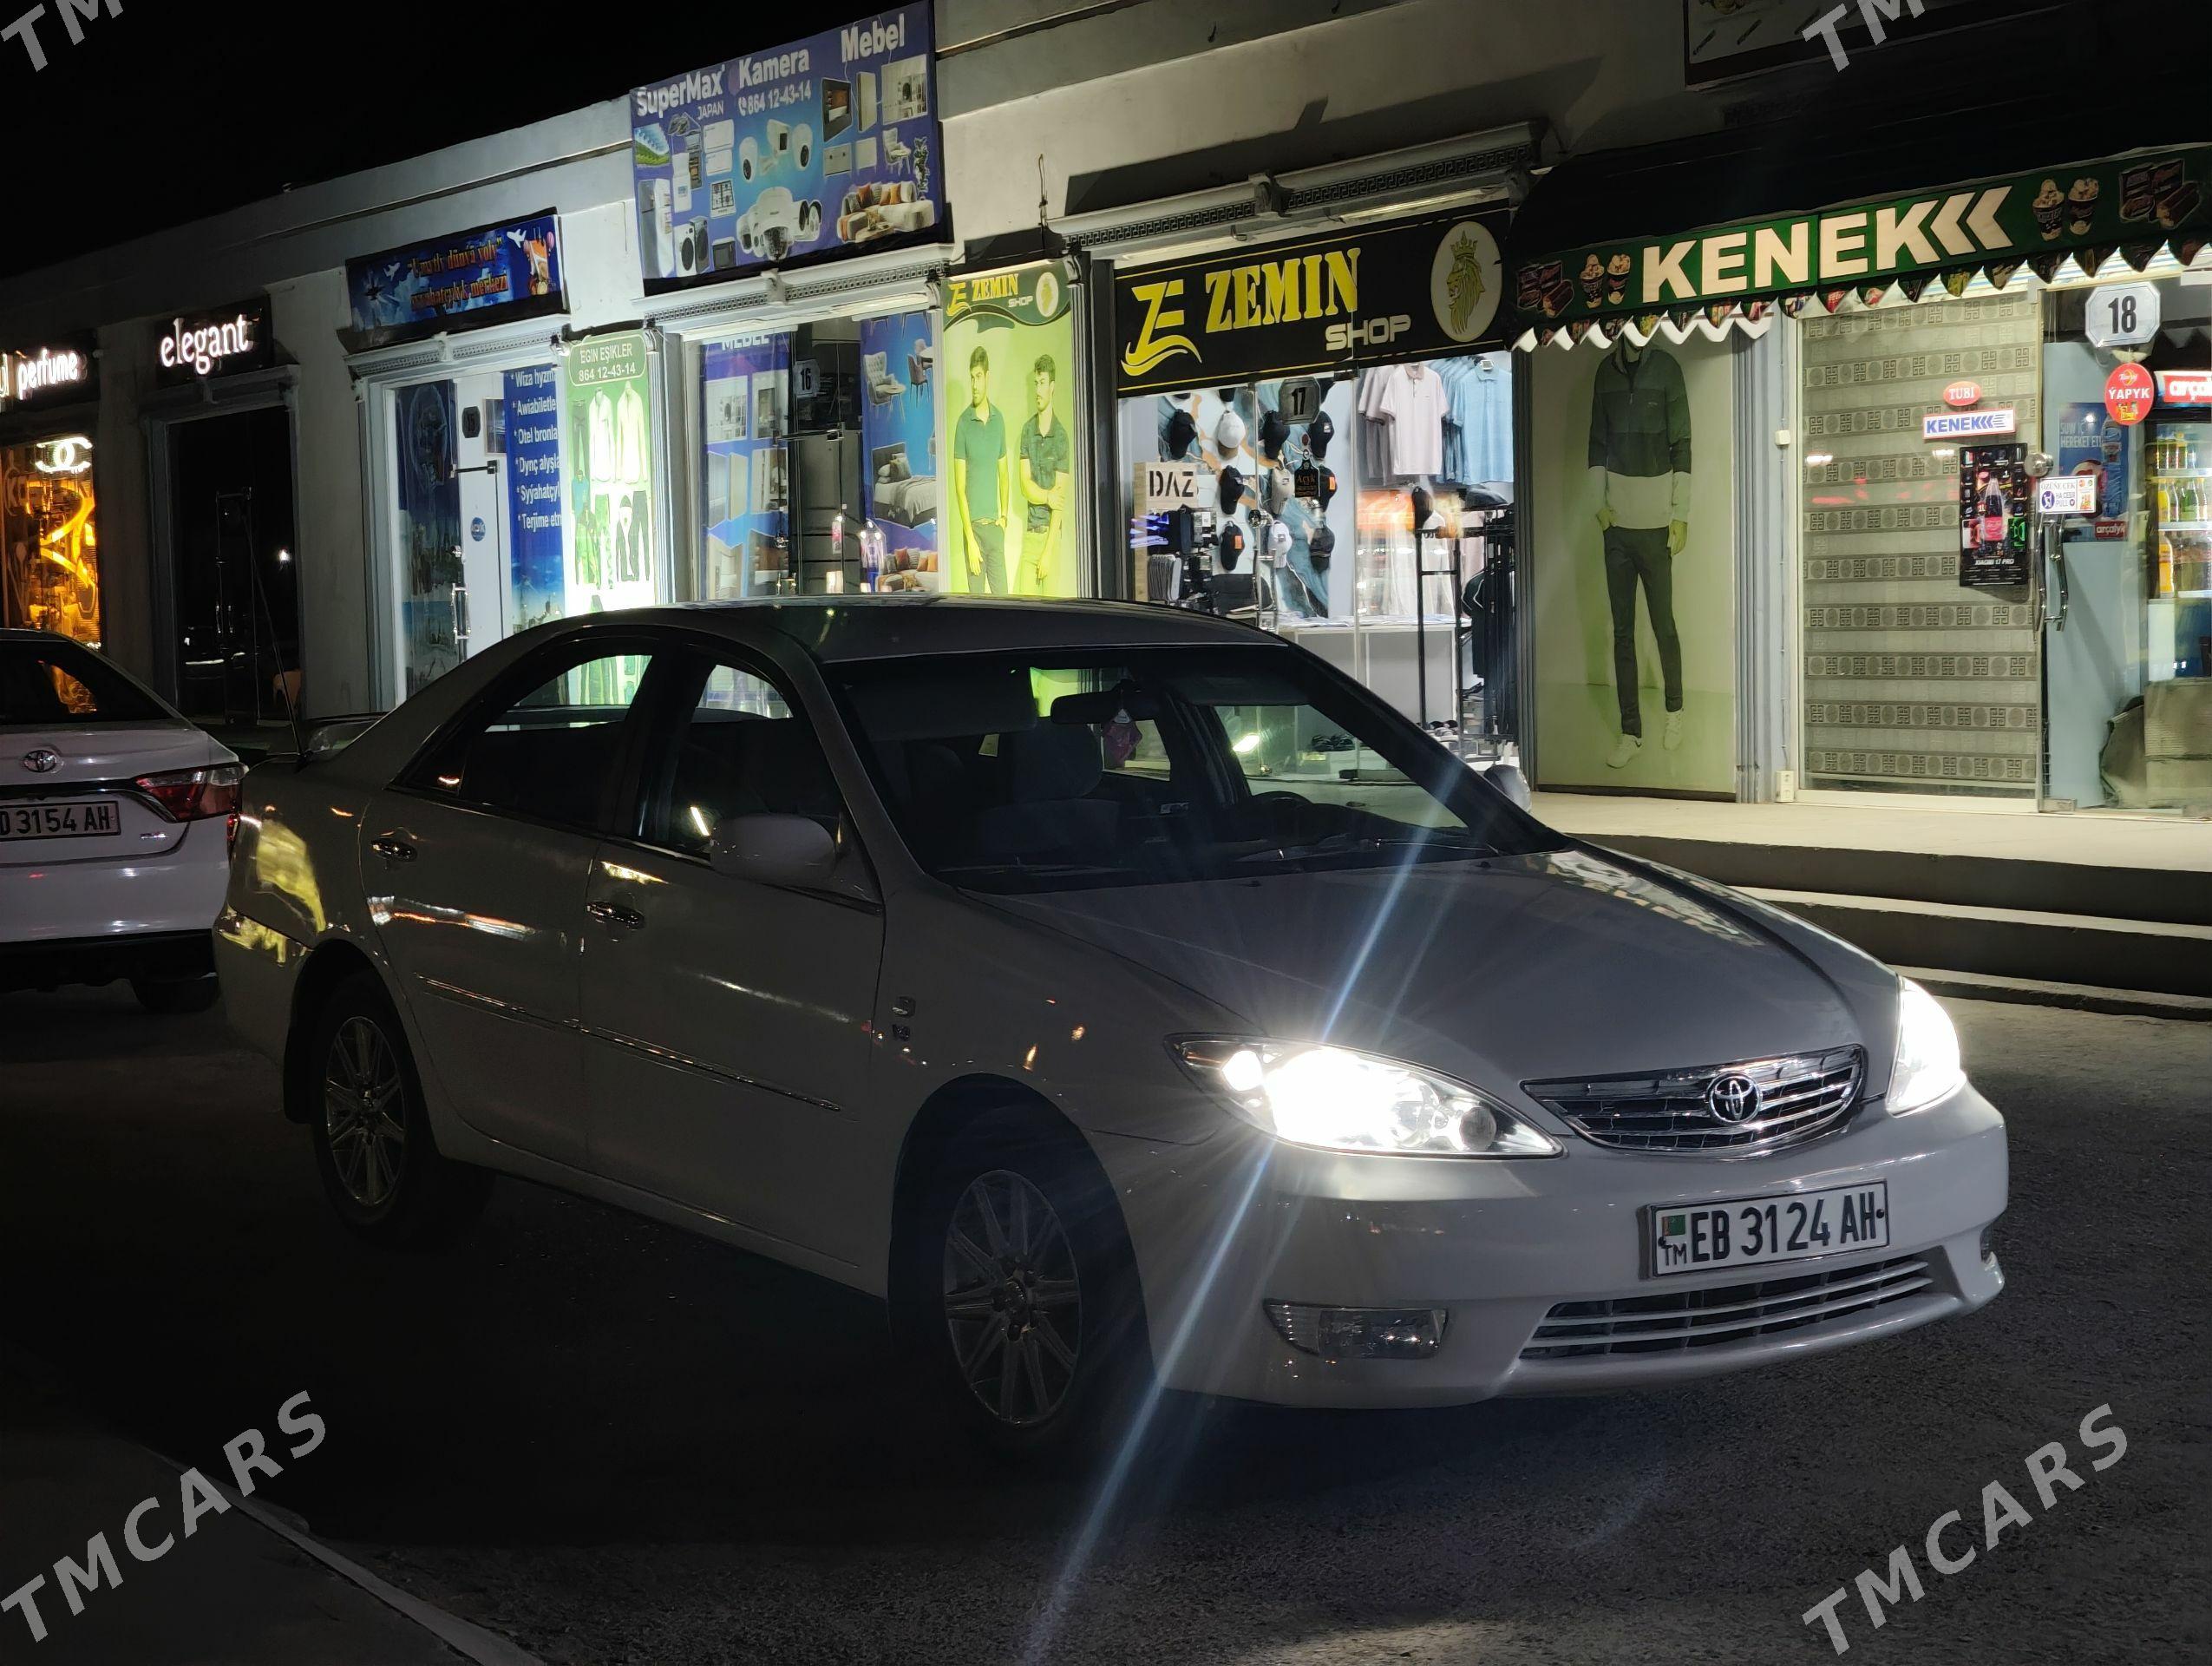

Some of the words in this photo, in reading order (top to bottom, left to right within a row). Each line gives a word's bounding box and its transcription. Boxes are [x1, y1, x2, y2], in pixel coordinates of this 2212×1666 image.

[841, 13, 905, 62] Mebel
[739, 48, 810, 89] Kamera
[697, 101, 723, 121] JAPAN
[747, 94, 765, 116] 864
[769, 81, 811, 108] 12-43-14
[1642, 200, 1941, 303] KENEK
[972, 273, 1019, 302] ZEMIN
[1205, 247, 1361, 334] ZEMIN
[1008, 295, 1033, 308] SHOP
[2108, 295, 2137, 334] 18
[160, 313, 250, 375] elegant
[1325, 314, 1412, 351] SHOP
[579, 347, 599, 364] EGIN
[17, 348, 78, 400] perfume
[514, 371, 533, 388] Wiza
[579, 368, 595, 382] 864
[598, 362, 636, 379] 12-43-14
[800, 368, 811, 390] 16
[1292, 387, 1306, 416] 17
[1948, 387, 1975, 400] TUBI
[2108, 386, 2150, 400] ÝAPYK
[517, 397, 556, 417] Awiabiletle
[518, 427, 533, 444] Otel
[1927, 416, 1981, 434] KENEK
[520, 456, 538, 476] Dynç
[1149, 470, 1194, 497] DAZ
[522, 513, 549, 533] Terjime
[16, 807, 76, 834] 3154
[84, 805, 110, 831] AH
[1692, 1209, 1730, 1263] EB
[1740, 1198, 1830, 1256] 3124
[1841, 1190, 1877, 1243] AH
[1663, 1243, 1687, 1266] TM
